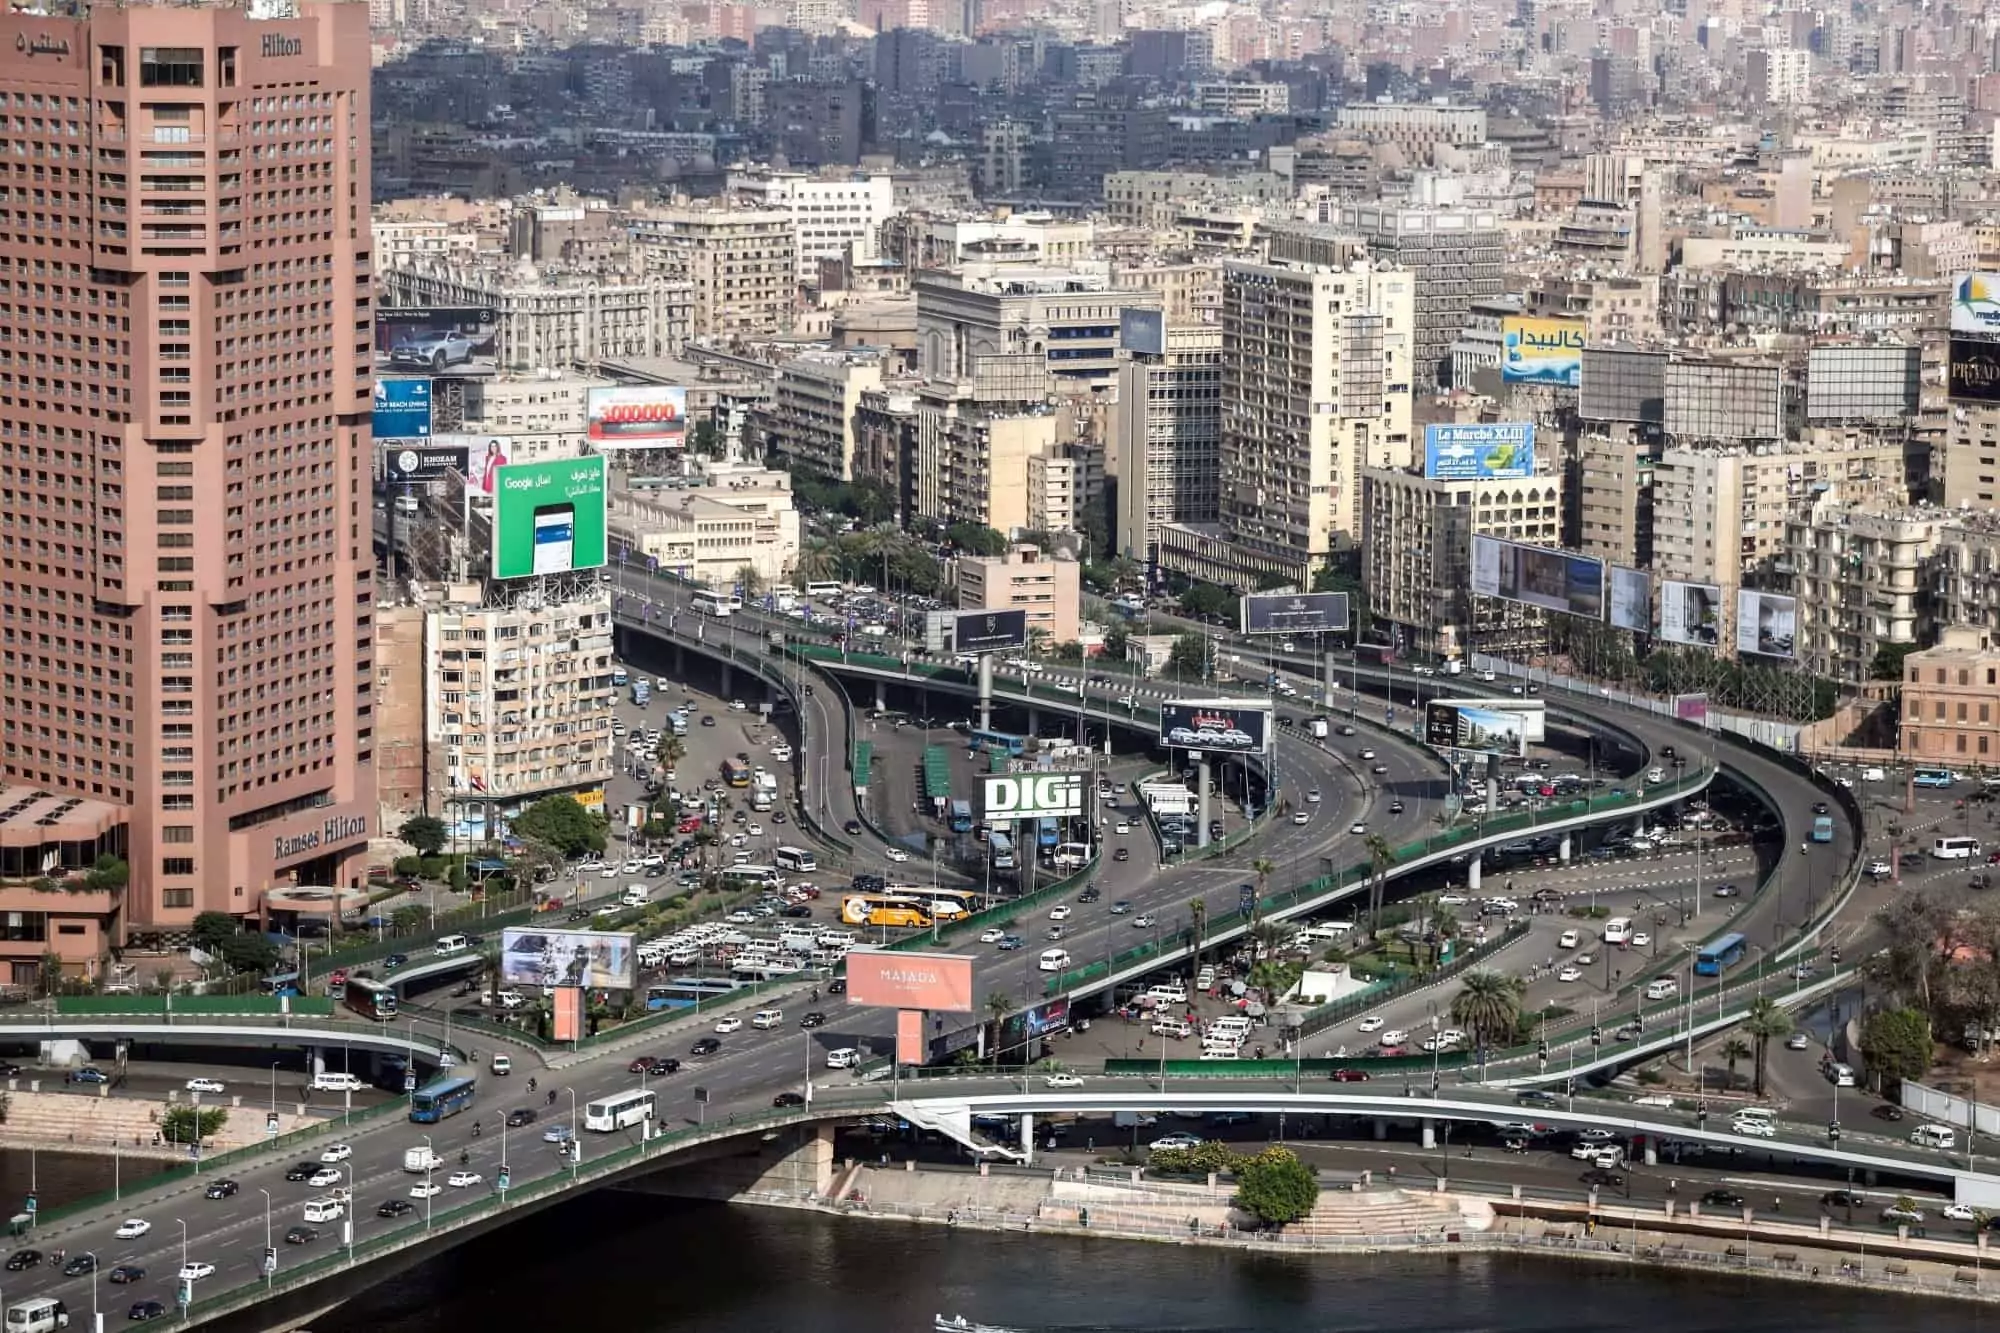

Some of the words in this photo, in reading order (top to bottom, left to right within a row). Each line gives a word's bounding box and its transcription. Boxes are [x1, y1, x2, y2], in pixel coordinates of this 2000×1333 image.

[16, 31, 70, 63] هيلتون
[262, 32, 302, 57] Hilton
[1520, 327, 1584, 351] كالبيدا
[1438, 429, 1451, 441] Le
[1453, 427, 1493, 441] Marché
[423, 455, 457, 463] KHOZAM
[504, 476, 533, 490] Google
[275, 831, 319, 860] Ramses
[324, 816, 366, 845] Hilton
